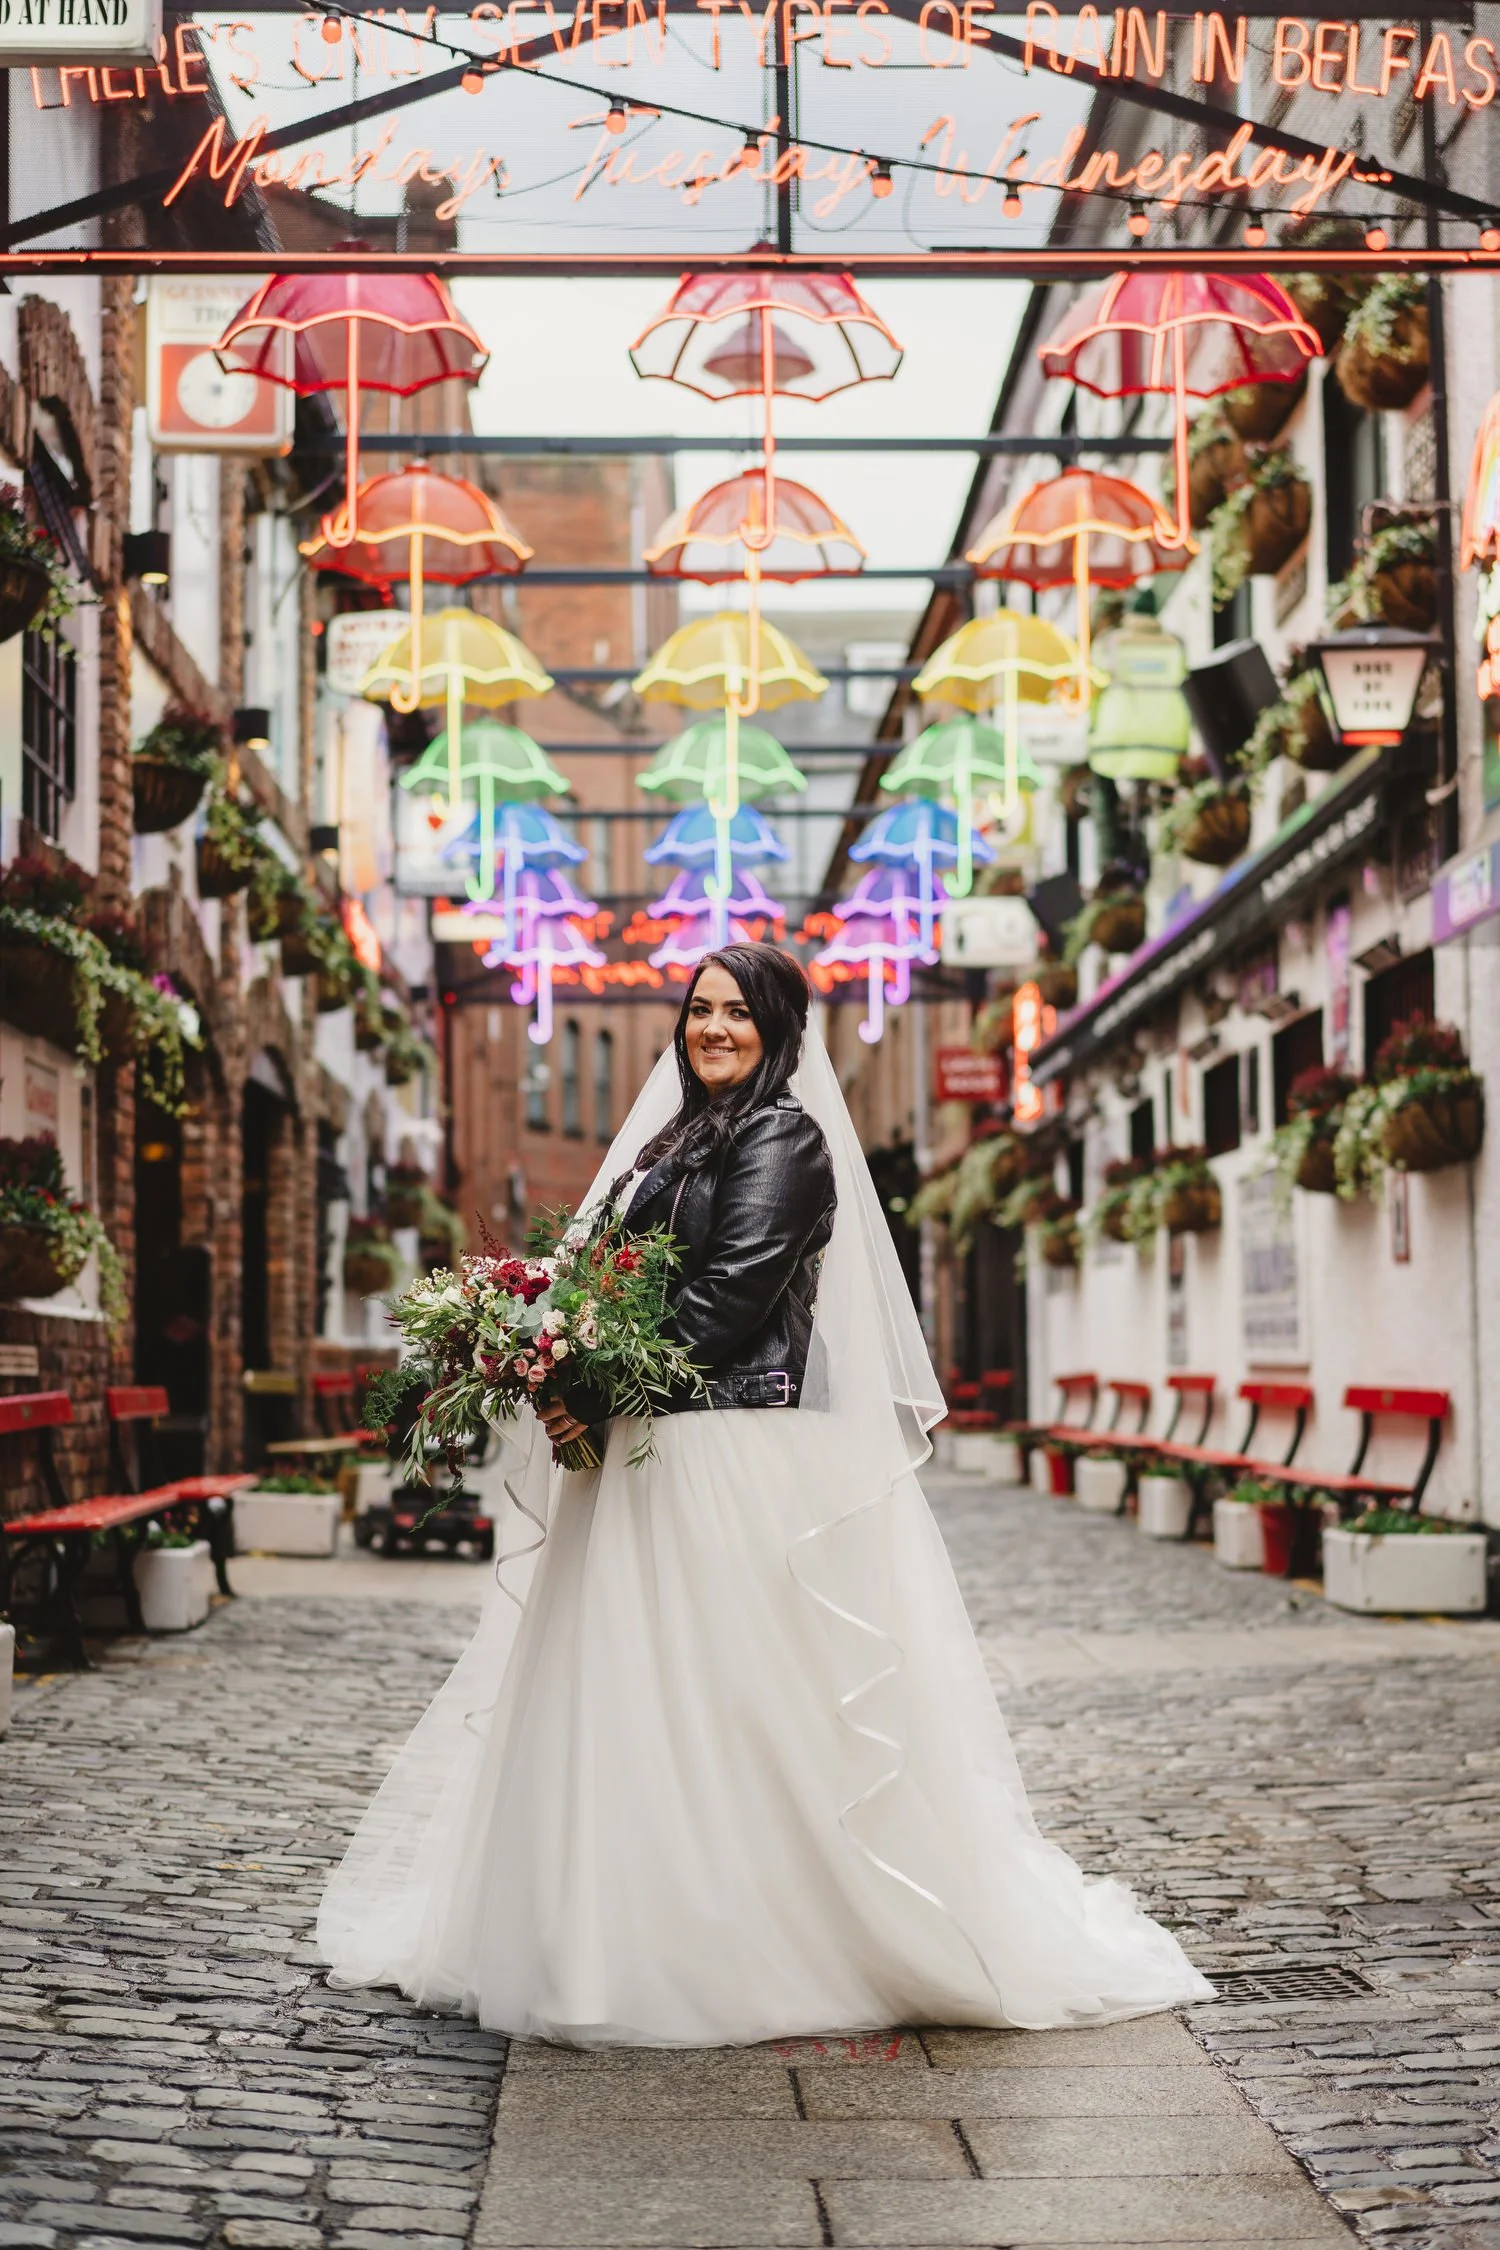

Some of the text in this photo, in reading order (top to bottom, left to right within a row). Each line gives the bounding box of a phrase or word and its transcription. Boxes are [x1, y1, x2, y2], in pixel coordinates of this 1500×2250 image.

[58, 0, 129, 25] HAND
[293, 4, 439, 82] ONLY
[471, 0, 667, 71] SEVEN
[696, 0, 893, 69] TYPES
[919, 0, 996, 68] OF
[1023, 0, 1167, 78] RAIN
[1192, 11, 1247, 83] IN
[1272, 16, 1497, 106] BELFAS
